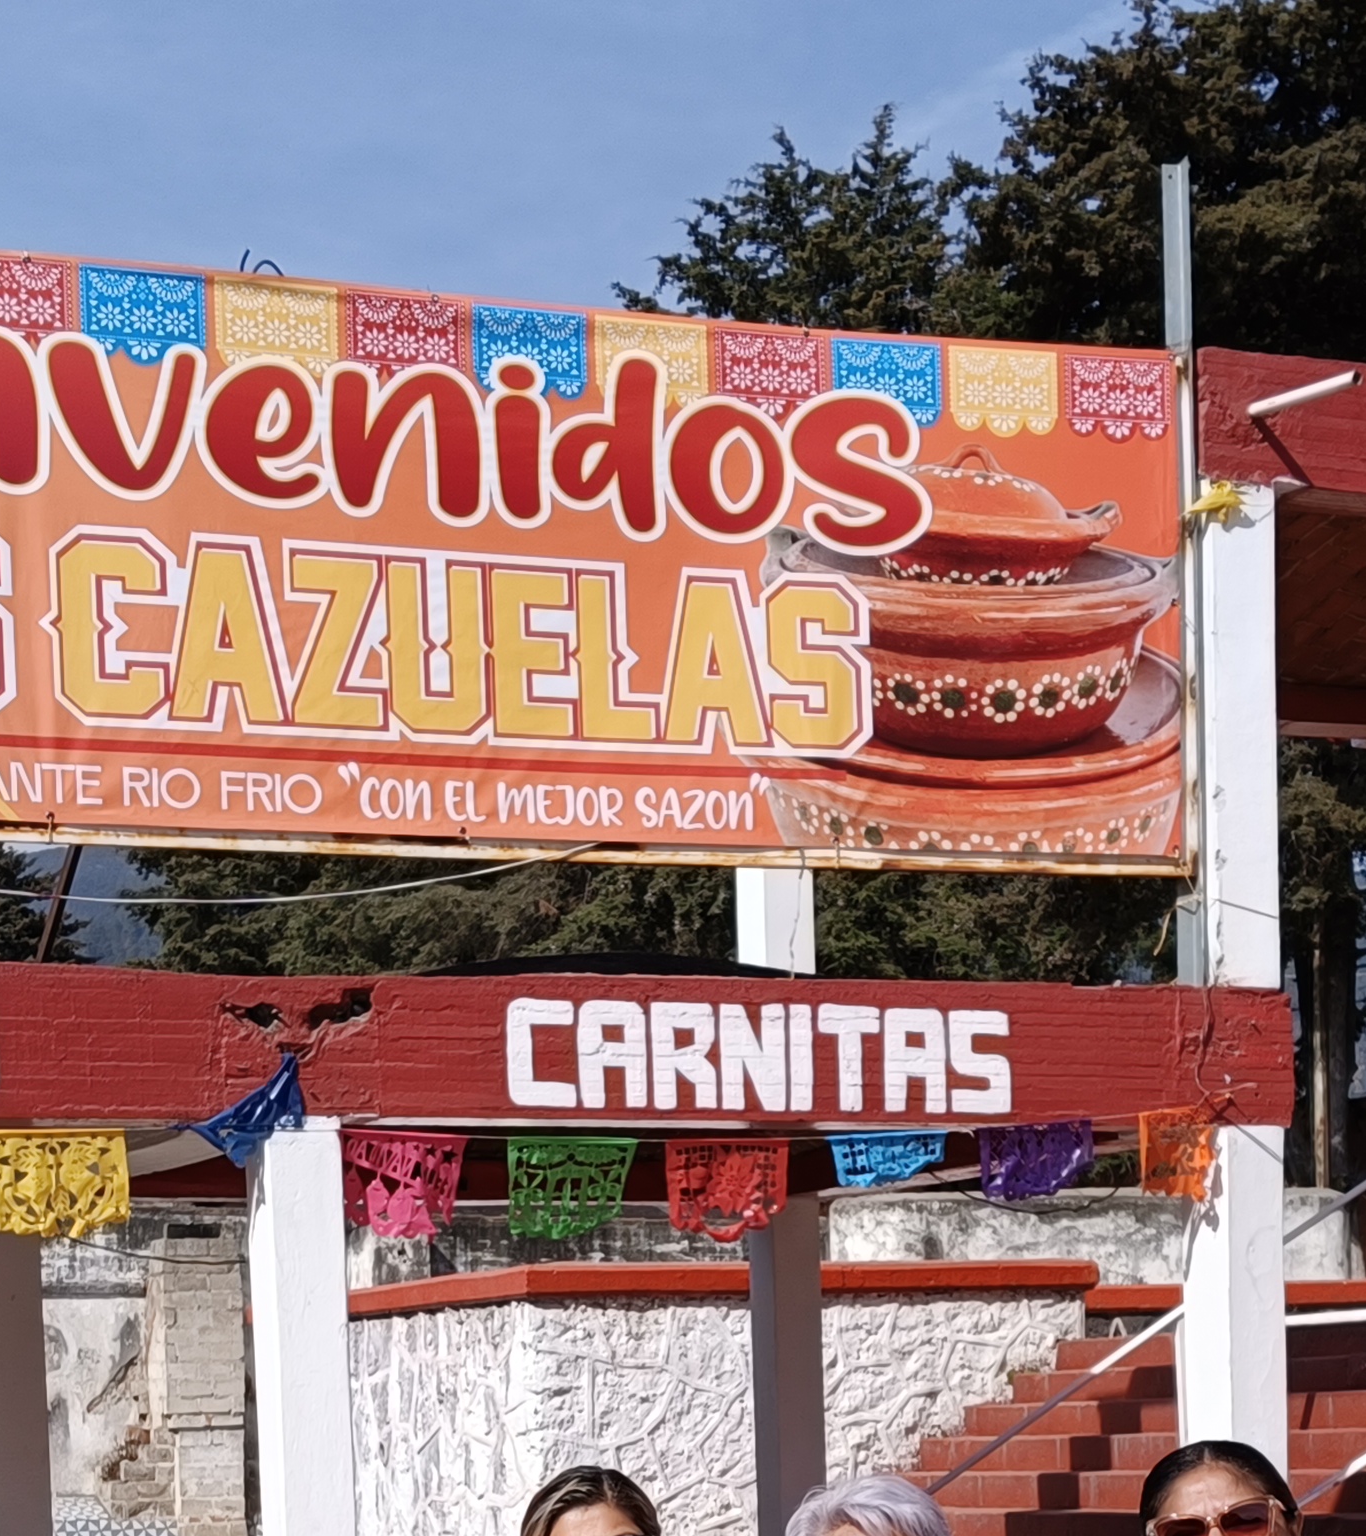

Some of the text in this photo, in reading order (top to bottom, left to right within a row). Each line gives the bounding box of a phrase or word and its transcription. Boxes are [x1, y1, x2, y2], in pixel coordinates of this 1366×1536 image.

[37, 524, 873, 759] CAZUELAS
[121, 766, 202, 811] RIO
[219, 770, 324, 816] FRIO
[443, 779, 487, 824] EL
[496, 780, 624, 829] MEJOR
[504, 997, 1012, 1116] CARNITAS
